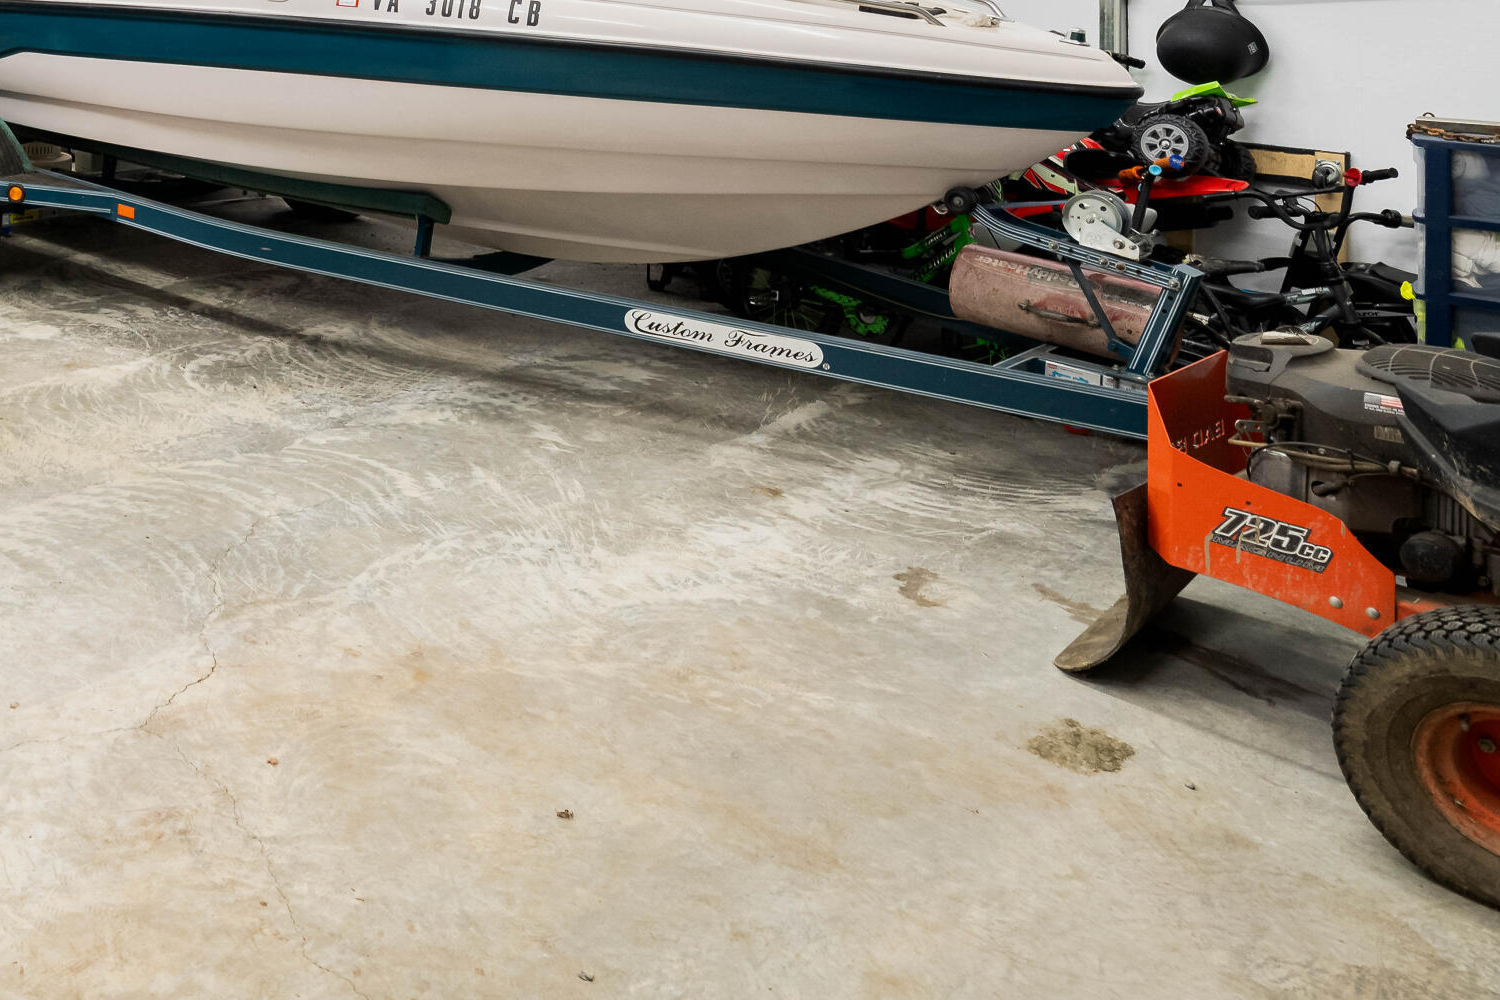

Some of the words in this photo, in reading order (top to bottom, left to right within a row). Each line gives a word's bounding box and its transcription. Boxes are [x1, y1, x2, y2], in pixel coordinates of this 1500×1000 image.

[631, 310, 715, 345] Custom
[724, 329, 820, 363] Frames
[1214, 507, 1332, 563] 725cc
